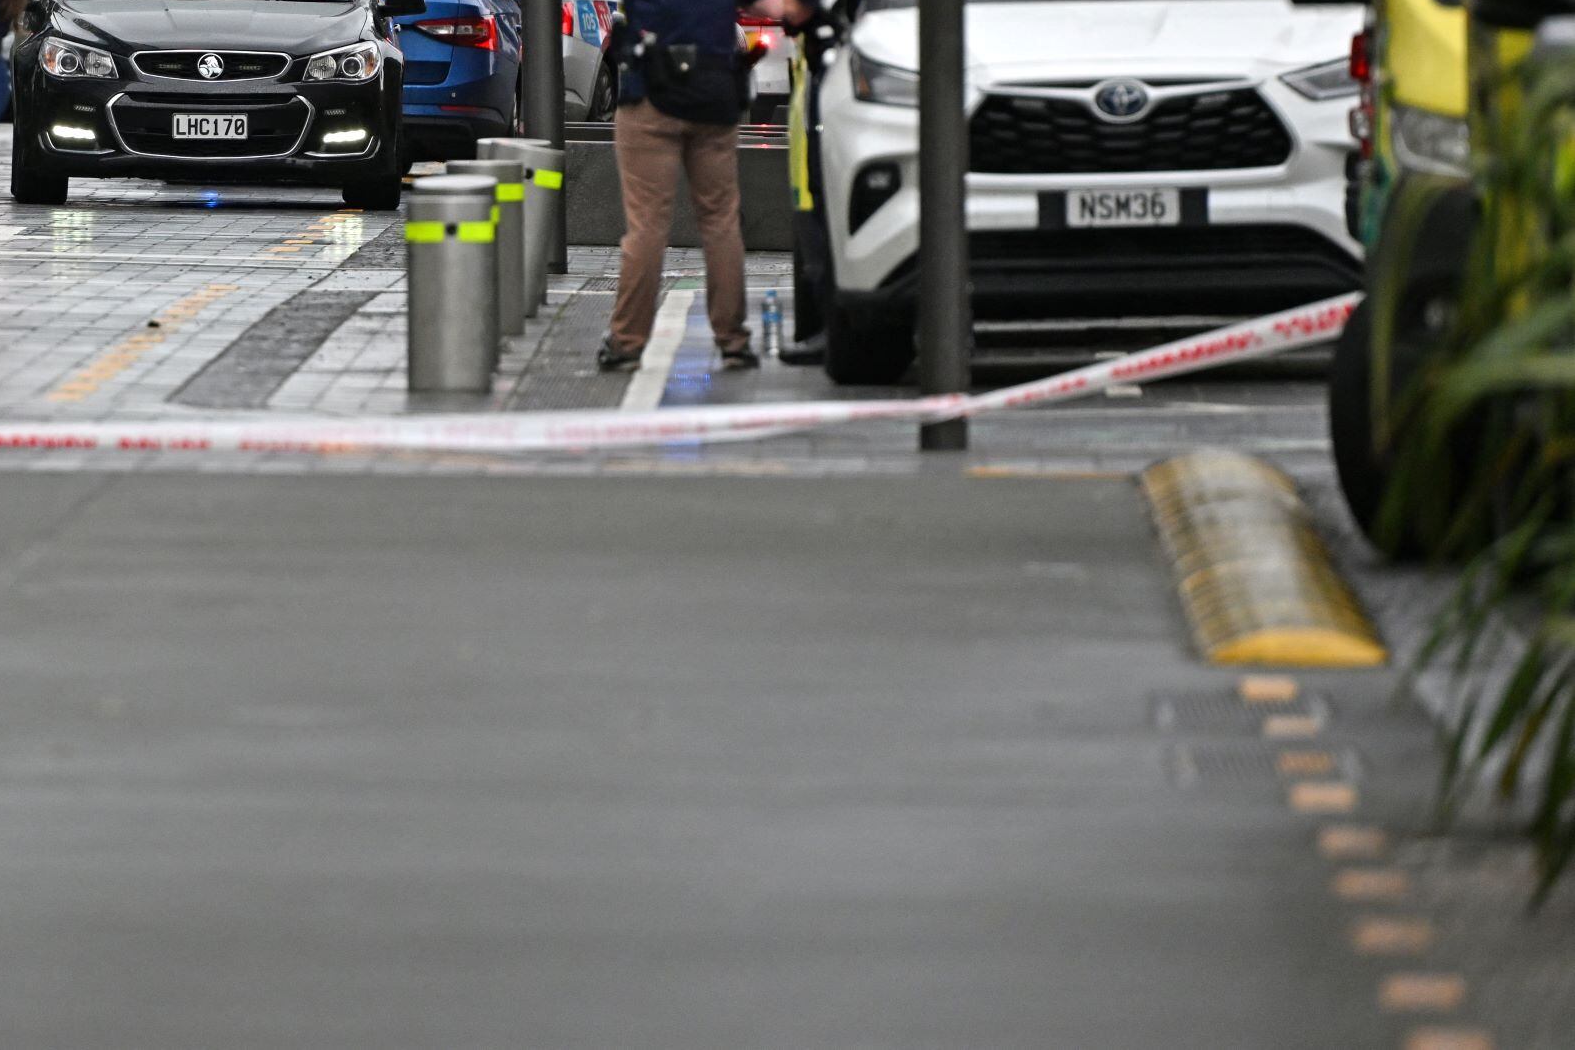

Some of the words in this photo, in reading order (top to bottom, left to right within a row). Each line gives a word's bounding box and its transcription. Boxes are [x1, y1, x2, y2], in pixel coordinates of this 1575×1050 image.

[582, 12, 596, 31] 105
[175, 118, 245, 136] LHC170
[1080, 192, 1166, 220] NSM36
